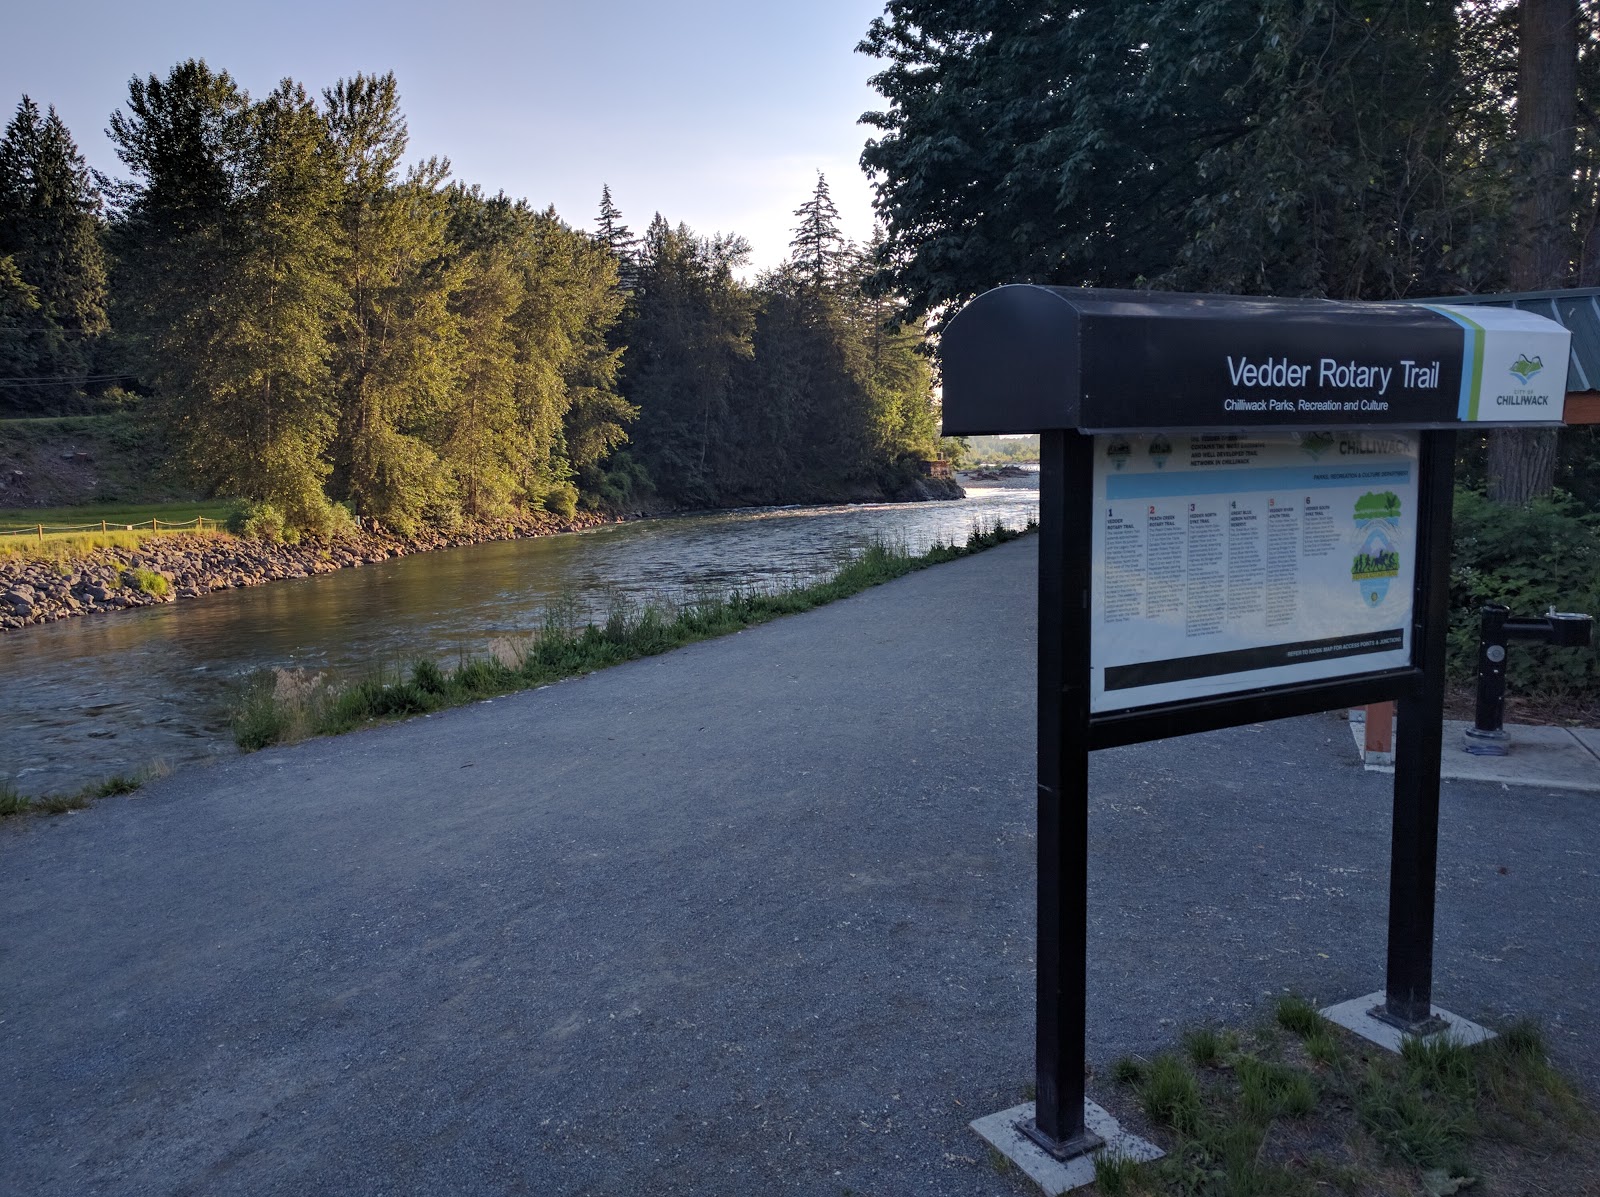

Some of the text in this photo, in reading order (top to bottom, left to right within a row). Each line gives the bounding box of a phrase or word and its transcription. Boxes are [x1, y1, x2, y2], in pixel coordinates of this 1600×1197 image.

[1227, 356, 1439, 394] Vedder Rotary Trail
[1496, 395, 1548, 405] CHILLIWACK
[1224, 399, 1388, 412] Chilliwack Parks, Recreation and Culture
[1232, 501, 1236, 509] 4
[1270, 498, 1274, 506] 5
[1108, 509, 1112, 517] 1
[1150, 506, 1155, 514] 2
